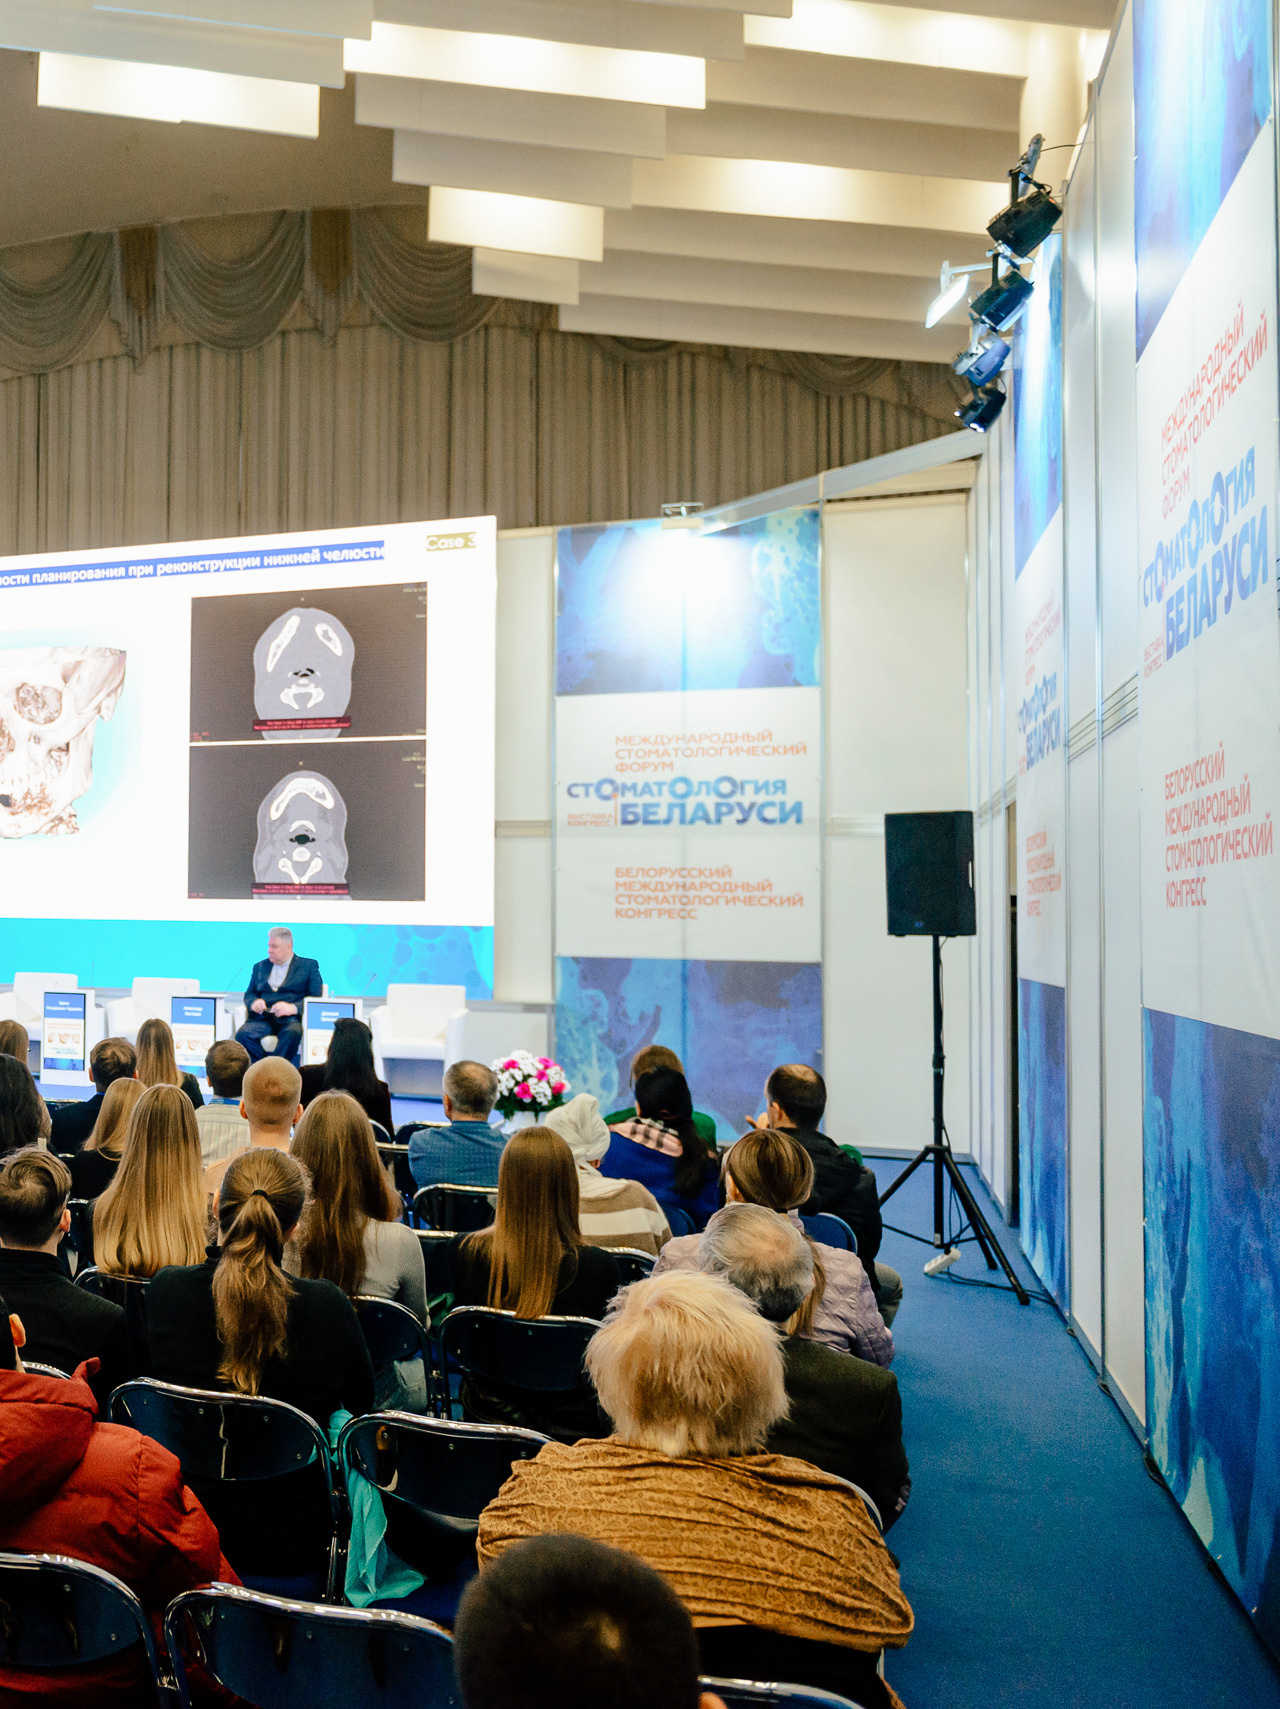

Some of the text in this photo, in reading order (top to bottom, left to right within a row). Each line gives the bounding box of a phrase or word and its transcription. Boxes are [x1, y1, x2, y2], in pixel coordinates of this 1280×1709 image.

[1161, 298, 1244, 450] МЕЖДУНАРОДНЫЙ
[1161, 309, 1268, 486] СТОМАТОЛОГИЧЕСКИЙ
[1162, 463, 1190, 521] ФОРУМ
[427, 533, 476, 550] Case 3
[1143, 445, 1256, 608] СТОМАТОЛОГИЯ
[32, 565, 126, 583] планирования
[128, 563, 153, 578] при
[156, 556, 261, 577] реконструкции
[263, 548, 320, 567] нижней
[323, 545, 385, 562] челюсти
[1165, 504, 1269, 662] БЕЛАРУСИ
[615, 729, 773, 746] МЕЖДУНАРОДНЫЙ
[615, 741, 807, 759] СТОМАТОЛОГИЧЕСКИЙ
[615, 761, 674, 773] ФОРУМ
[1165, 740, 1225, 801] БЕЛОРУССКИЙ
[566, 775, 787, 802] СТОМАТОЛОГИЯ
[620, 801, 804, 826] БЕЛАРУСИ
[1165, 772, 1251, 837] МЕЖДУНАРОДНЫЙ
[1165, 811, 1273, 873] СТОМАТОЛОГИЧЕСКИЙ
[615, 865, 733, 878] БЕЛОРУССКИЙ
[615, 879, 773, 893] МЕЖДУНАРОДНЫЙ
[614, 893, 804, 907] СТОМАТОЛОГИЧЕСКИЙ
[1165, 876, 1207, 909] КОНГРЕСС
[615, 908, 698, 920] КОНГРЕСС
